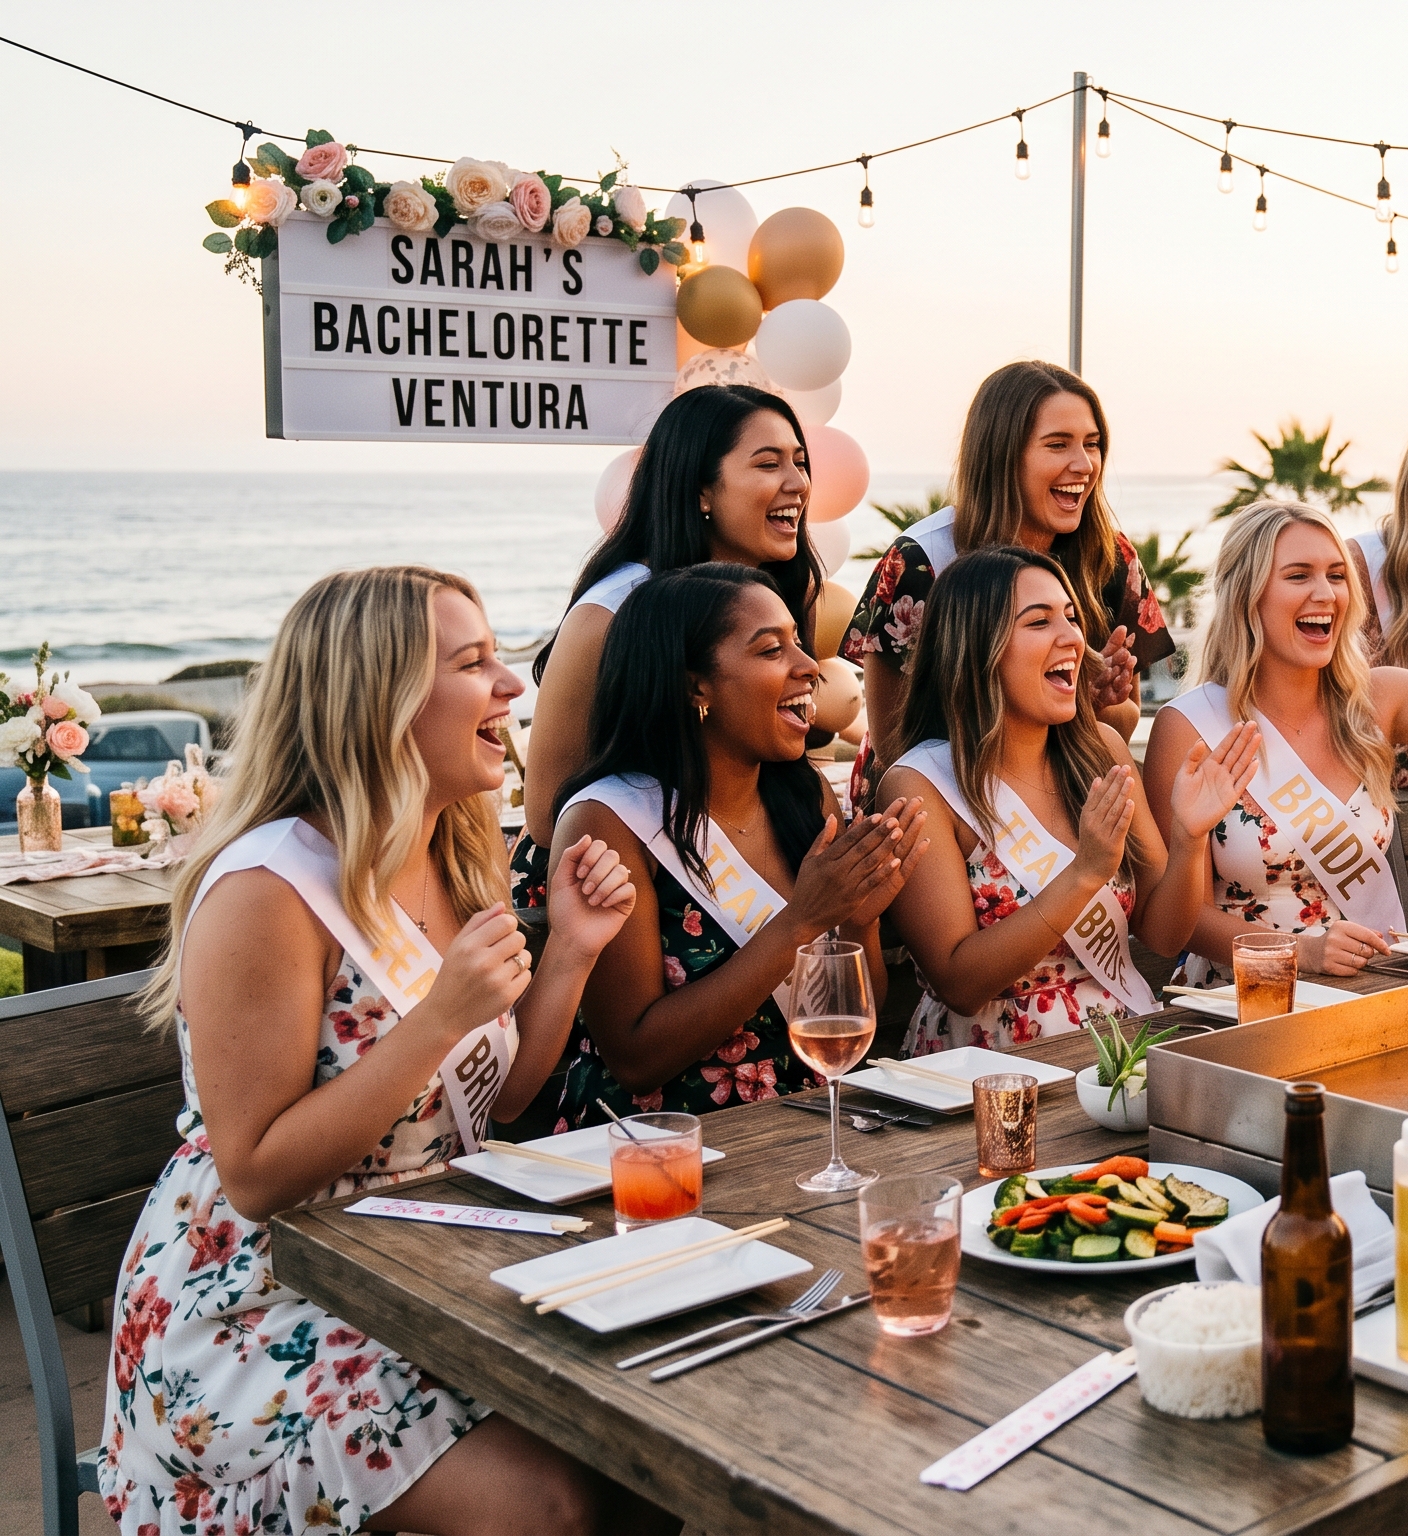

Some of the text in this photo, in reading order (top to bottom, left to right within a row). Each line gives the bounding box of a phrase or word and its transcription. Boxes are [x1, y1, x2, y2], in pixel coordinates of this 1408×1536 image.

[390, 234, 583, 296] SARAH'S
[313, 301, 648, 366] BACHELORETTE
[391, 377, 589, 431] VENTURA
[1267, 773, 1381, 902] BRIDE
